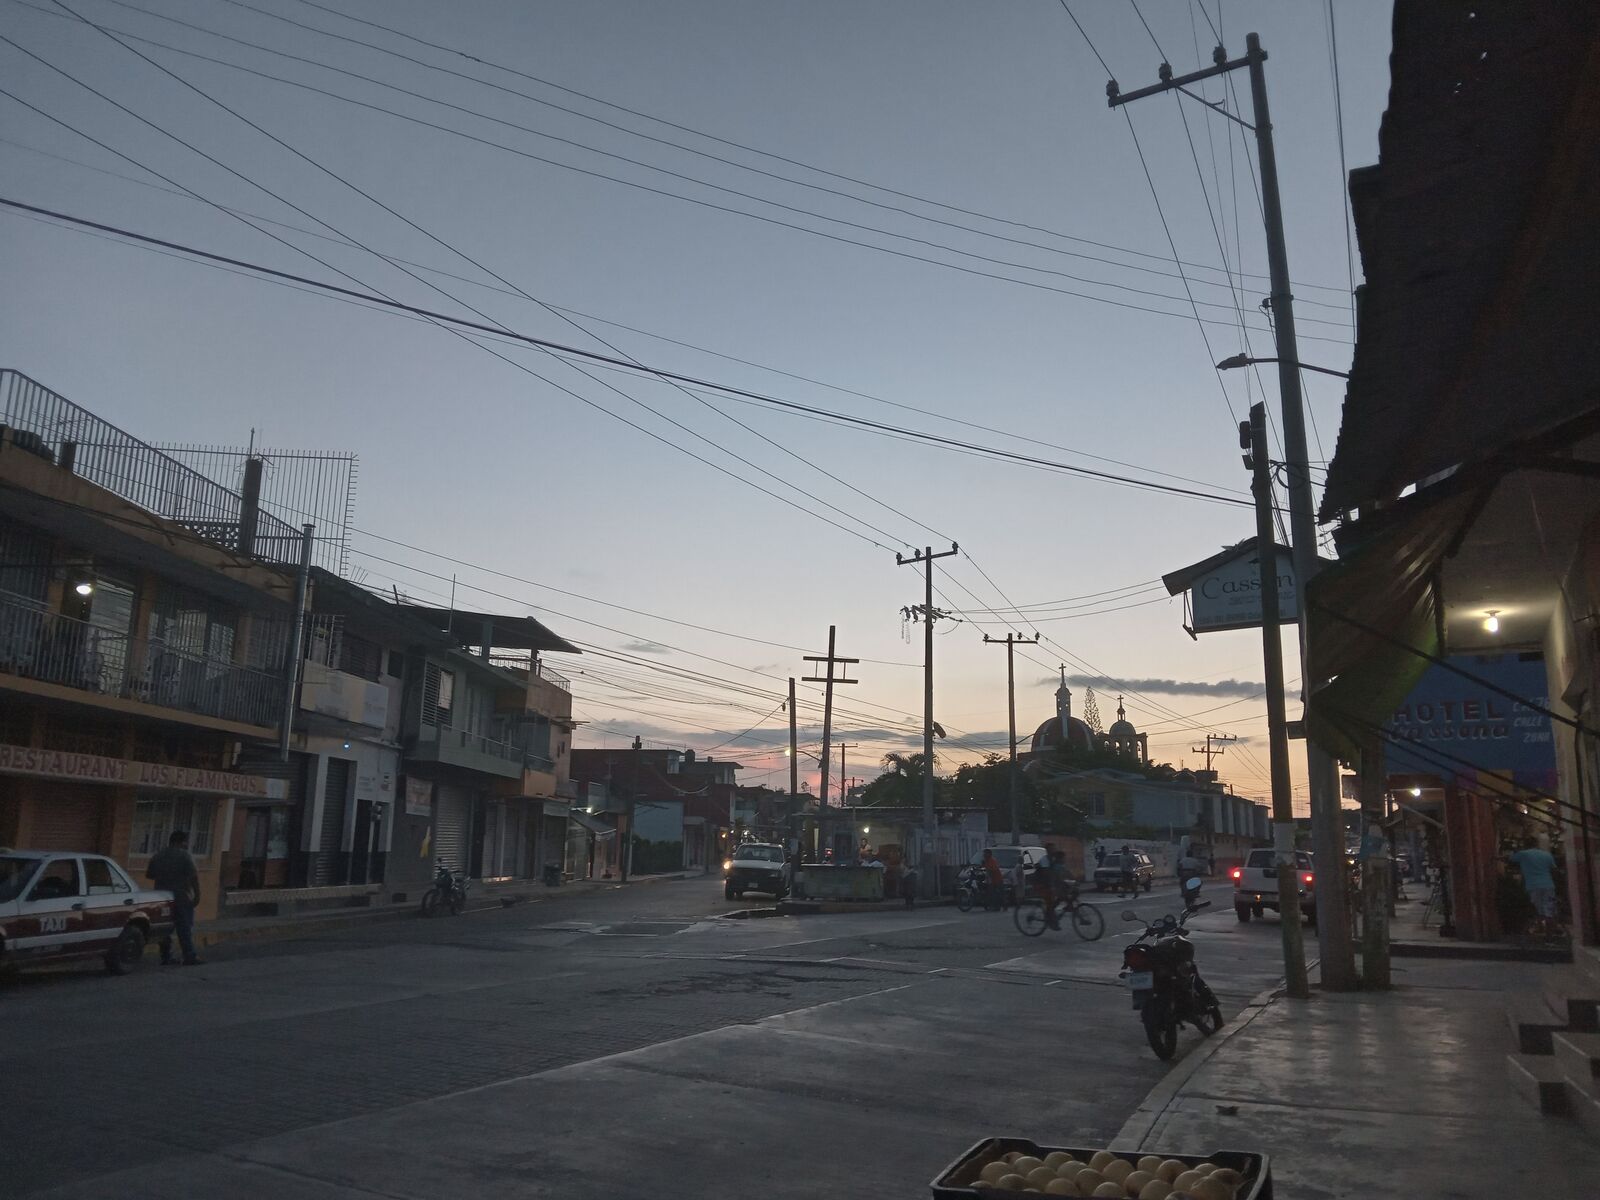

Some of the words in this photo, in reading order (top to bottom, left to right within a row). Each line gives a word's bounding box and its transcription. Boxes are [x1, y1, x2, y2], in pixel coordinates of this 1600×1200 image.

[1201, 575, 1293, 599] Cassn
[1392, 700, 1505, 726] HOTEL
[0, 745, 128, 780] RESTAURANT
[140, 764, 169, 785] LOS
[175, 768, 257, 793] FLAMINGOS
[39, 916, 66, 933] TAXI
